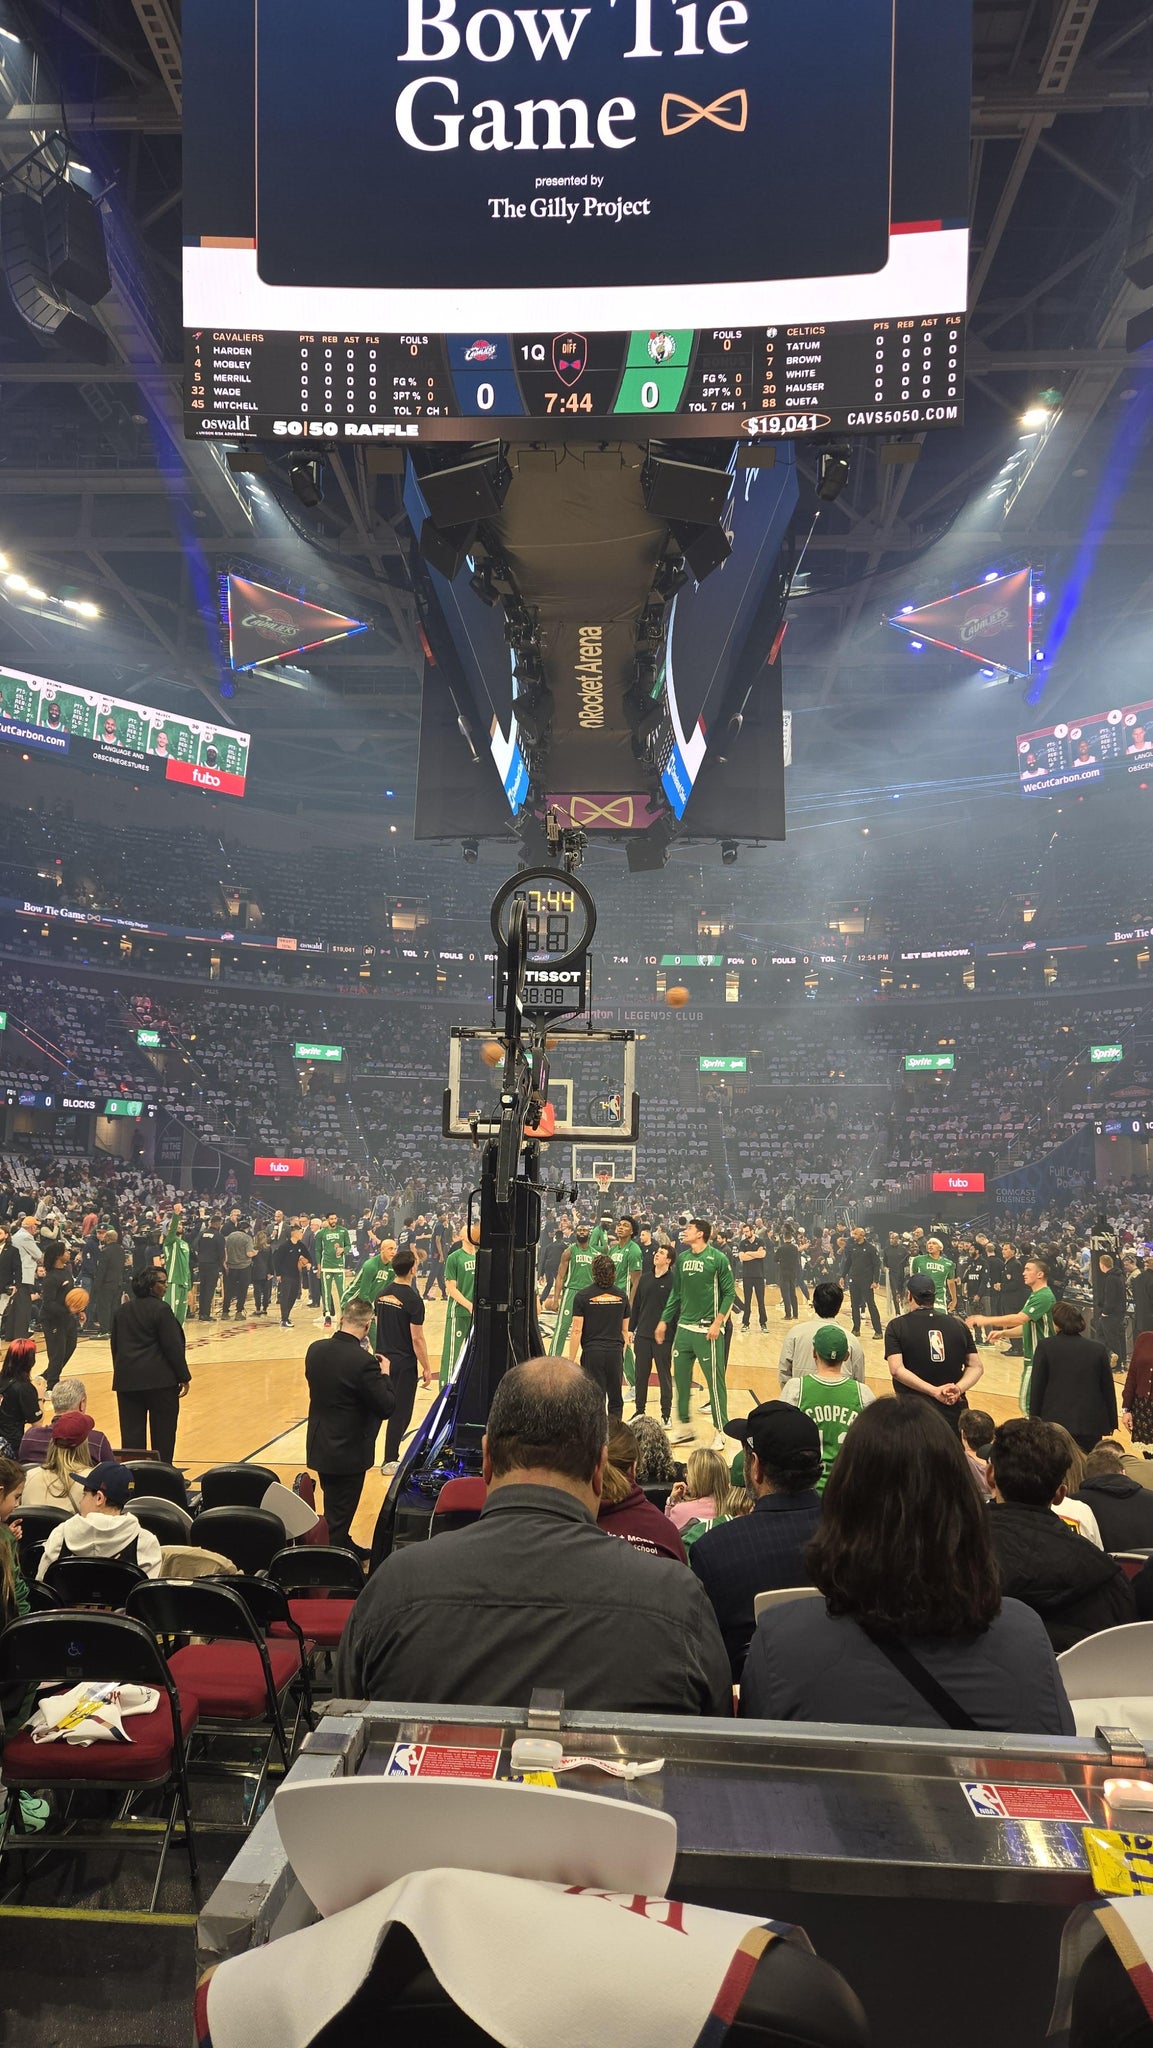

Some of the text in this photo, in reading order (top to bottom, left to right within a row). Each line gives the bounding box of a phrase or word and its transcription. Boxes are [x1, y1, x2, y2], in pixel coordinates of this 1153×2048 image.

[397, 0, 750, 62] Bow Tie
[395, 76, 636, 152] Game
[535, 174, 604, 188] presented by
[488, 195, 651, 224] The Gilly Project
[786, 317, 961, 336] CELTICS PTS REB AST FLS
[213, 332, 264, 342] CAVALIERS
[299, 335, 314, 343] PTS
[344, 336, 360, 344] AST
[713, 330, 742, 339] FOULS
[400, 336, 429, 345] FOULS
[723, 340, 731, 351] 0
[766, 331, 957, 352] 0 TATUM 0 0 0 0
[196, 346, 376, 359] 1 HARDEN 0 0 0 0
[410, 345, 418, 356] 0
[521, 344, 545, 361] 1Q
[562, 343, 577, 353] DIFF
[194, 359, 251, 369] 4 MOBLEY
[767, 355, 821, 366] 7 BROWN
[194, 373, 251, 383] 5 MERRILL
[702, 373, 742, 383] FG % 0
[766, 369, 816, 380] 9 WHITE
[393, 377, 434, 387] FG % 0
[191, 386, 241, 396] 32 WADE
[702, 387, 742, 397] 3PT % 0
[762, 382, 824, 394] 30 HAUSER
[393, 391, 434, 401] 3PT % 0
[476, 383, 494, 410] 0
[641, 381, 659, 408] 0
[191, 400, 258, 410] 45 MITCHELL
[544, 392, 593, 413] 7:44
[689, 401, 746, 412] TOL 7 CH 1
[762, 397, 818, 408] 88 QUETA
[393, 406, 448, 415] TOL 7 CH 1
[848, 406, 958, 425] CAVS5050.COM
[201, 415, 250, 430] oswald
[748, 415, 817, 436] $19,041
[273, 421, 338, 436] 50|50
[345, 424, 419, 436] RAFFLE
[574, 626, 604, 719] Rocket Arena
[101, 745, 144, 760] LANGUAGE AND
[93, 752, 150, 772] OBSCENEGESTURES
[192, 769, 220, 786] fubo
[1023, 769, 1100, 792] WeCutCarbon.com
[529, 891, 574, 912] 7:44
[24, 902, 86, 920] Bow Tie Game
[1114, 932, 1133, 940] Bow
[1135, 929, 1149, 937] Tie
[402, 950, 418, 958] TOL
[439, 952, 475, 961] FOULS 0
[937, 949, 970, 958] KNOW.
[752, 958, 757, 966] 0
[803, 956, 809, 964] 0
[525, 972, 581, 982] TISSOT
[624, 1011, 704, 1021] LEGENDS CLUB
[298, 1047, 321, 1056] Sprite
[702, 1060, 725, 1068] Sprite
[908, 1058, 932, 1067] Sprite
[45, 1097, 51, 1106] 0
[63, 1099, 95, 1109] BLOCKS
[111, 1103, 117, 1112] 0
[1132, 1121, 1140, 1132] 0
[270, 1162, 289, 1172] fubo
[1050, 1166, 1065, 1177] Full
[948, 1178, 968, 1188] fubo
[996, 1196, 1036, 1204] BUSINESS
[682, 1260, 704, 1272] CELTICS
[926, 1262, 945, 1272] CELTICS
[978, 1807, 995, 1815] NBA
